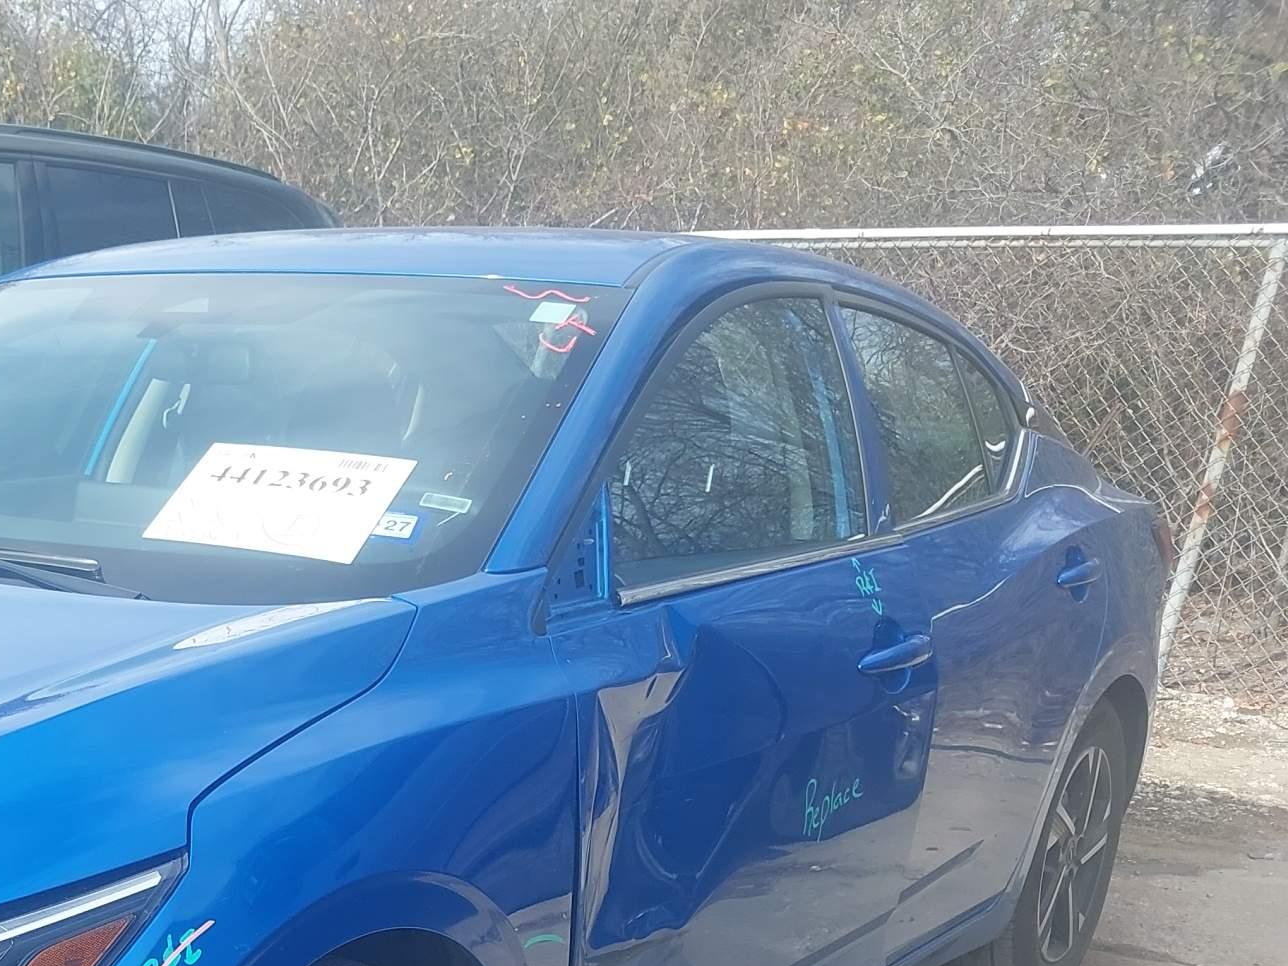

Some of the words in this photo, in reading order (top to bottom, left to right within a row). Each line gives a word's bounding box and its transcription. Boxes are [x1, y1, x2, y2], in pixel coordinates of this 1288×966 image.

[210, 465, 372, 496] 44123693
[383, 519, 412, 532] 27
[802, 777, 864, 843] Replace
